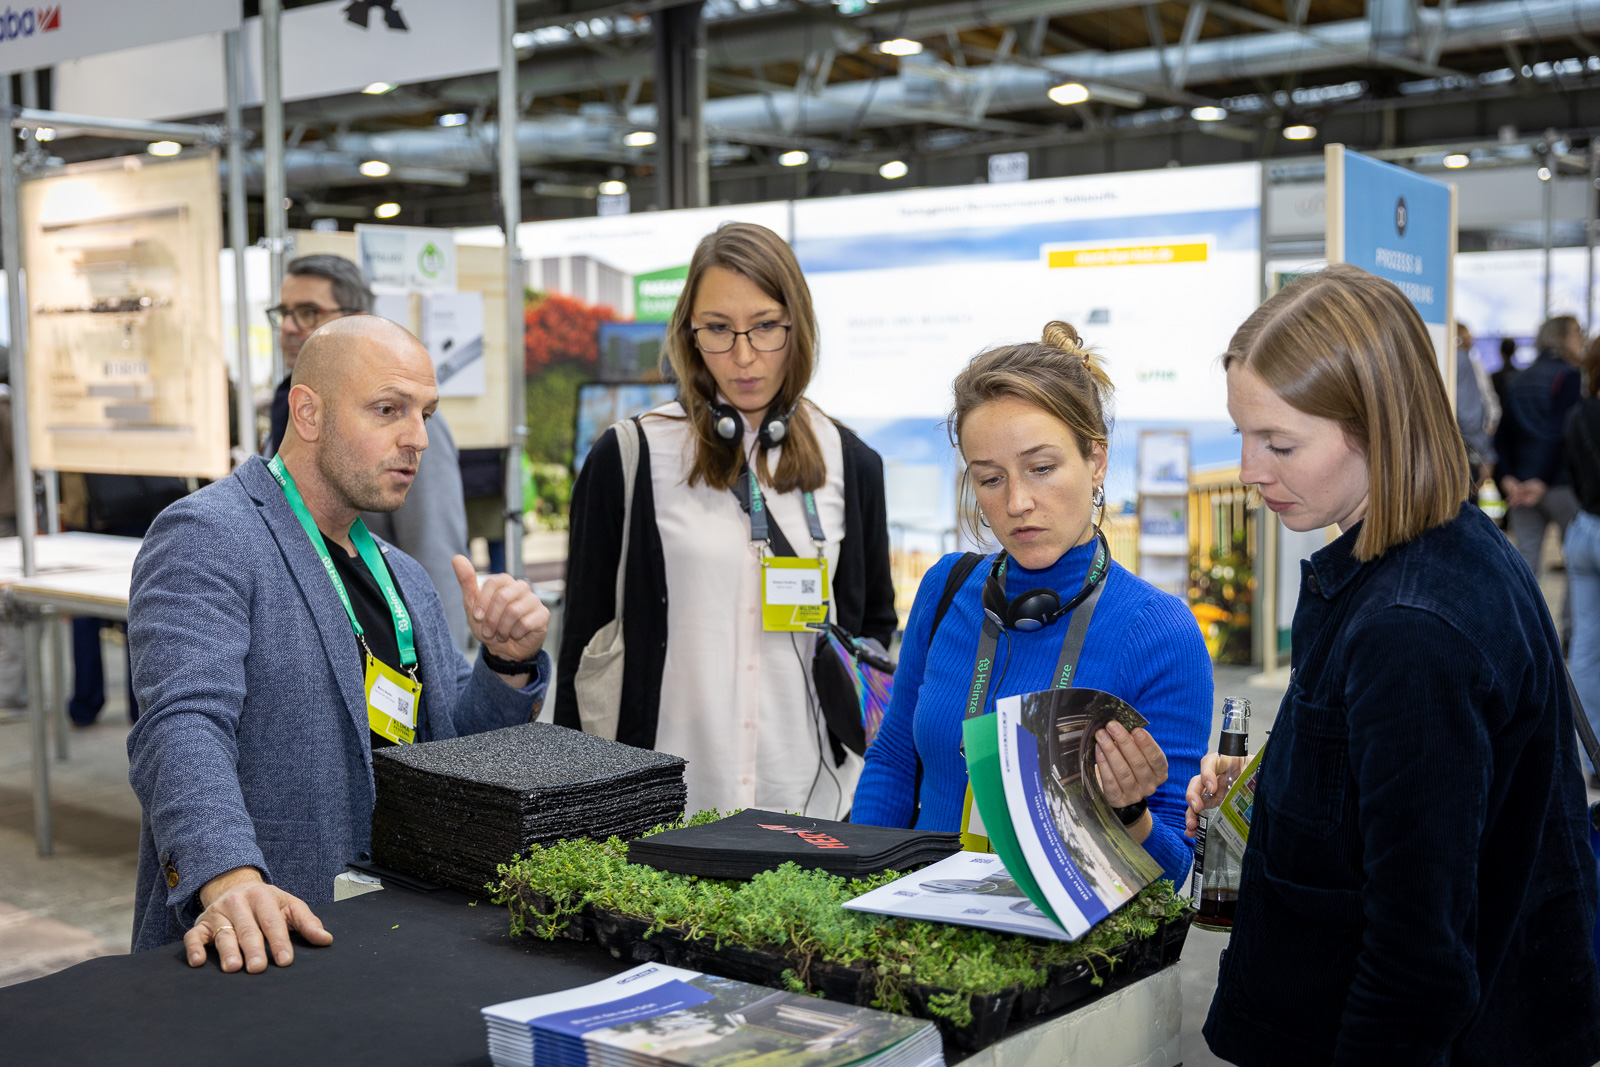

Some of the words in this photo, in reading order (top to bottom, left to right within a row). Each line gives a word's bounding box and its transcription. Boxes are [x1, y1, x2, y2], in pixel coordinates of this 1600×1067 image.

[1375, 247, 1414, 273] PROZESS
[329, 569, 350, 606] Heinze
[386, 586, 404, 617] Heinze
[969, 673, 987, 714] Heinze
